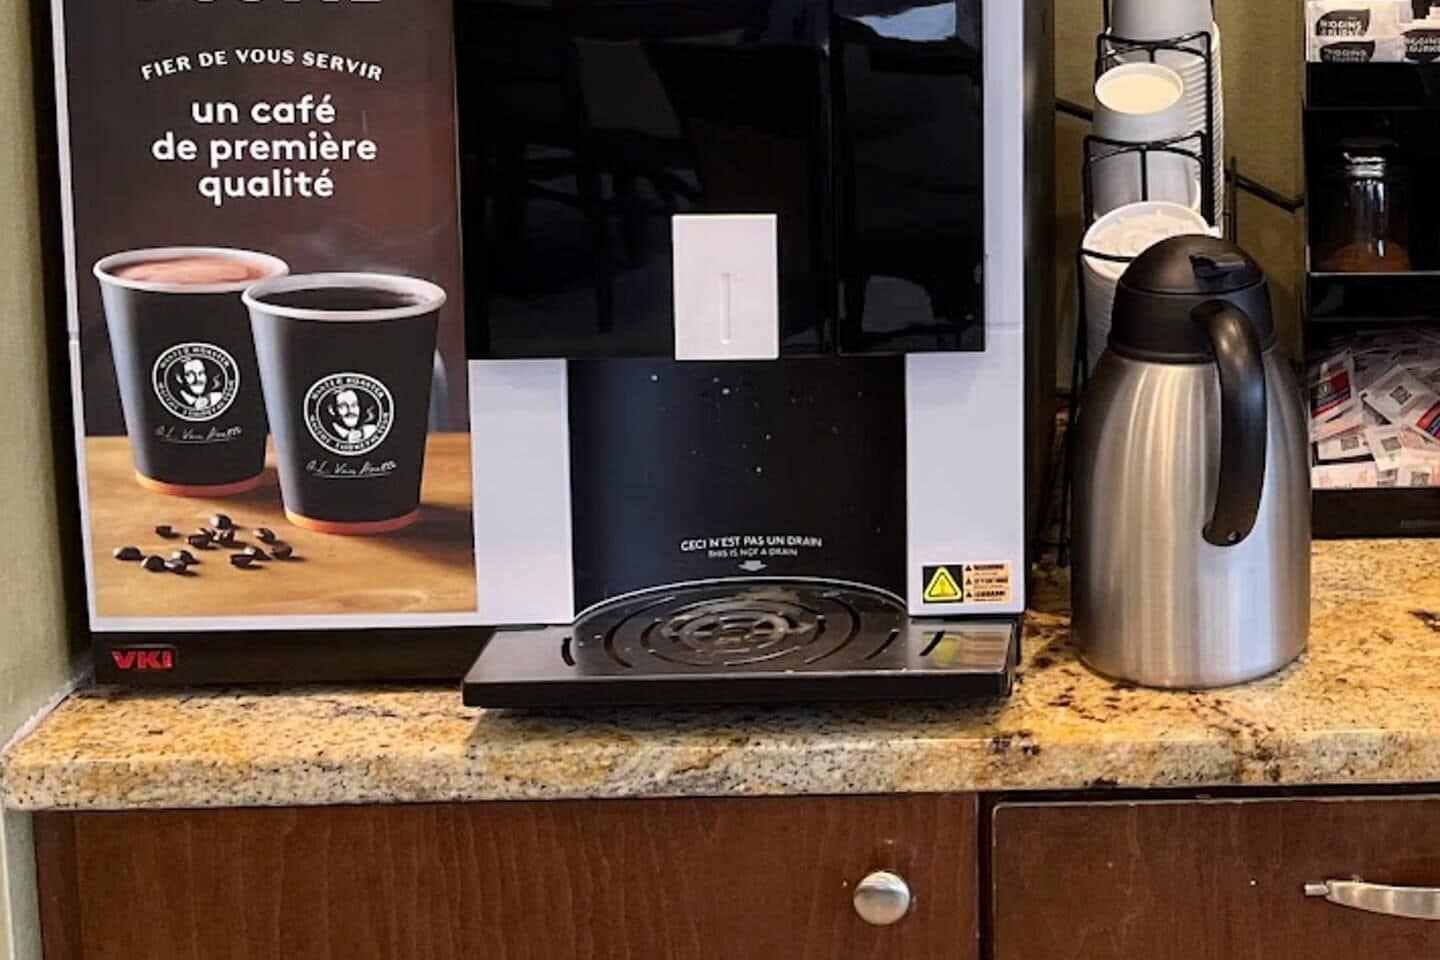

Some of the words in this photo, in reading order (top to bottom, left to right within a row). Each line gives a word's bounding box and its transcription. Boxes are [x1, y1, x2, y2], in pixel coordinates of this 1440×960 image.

[140, 55, 192, 81] FIER
[198, 51, 228, 68] DE
[235, 48, 295, 65] VOUS
[301, 51, 383, 81] SERVIR
[192, 101, 239, 124] un
[250, 94, 336, 124] café
[151, 131, 198, 161] de
[210, 131, 377, 169] première
[198, 167, 334, 207] qualité
[680, 539, 707, 552] CECI
[743, 535, 764, 547] PAS
[766, 535, 786, 547] UN
[786, 536, 823, 547] DRAIN
[112, 651, 173, 670] VKI
